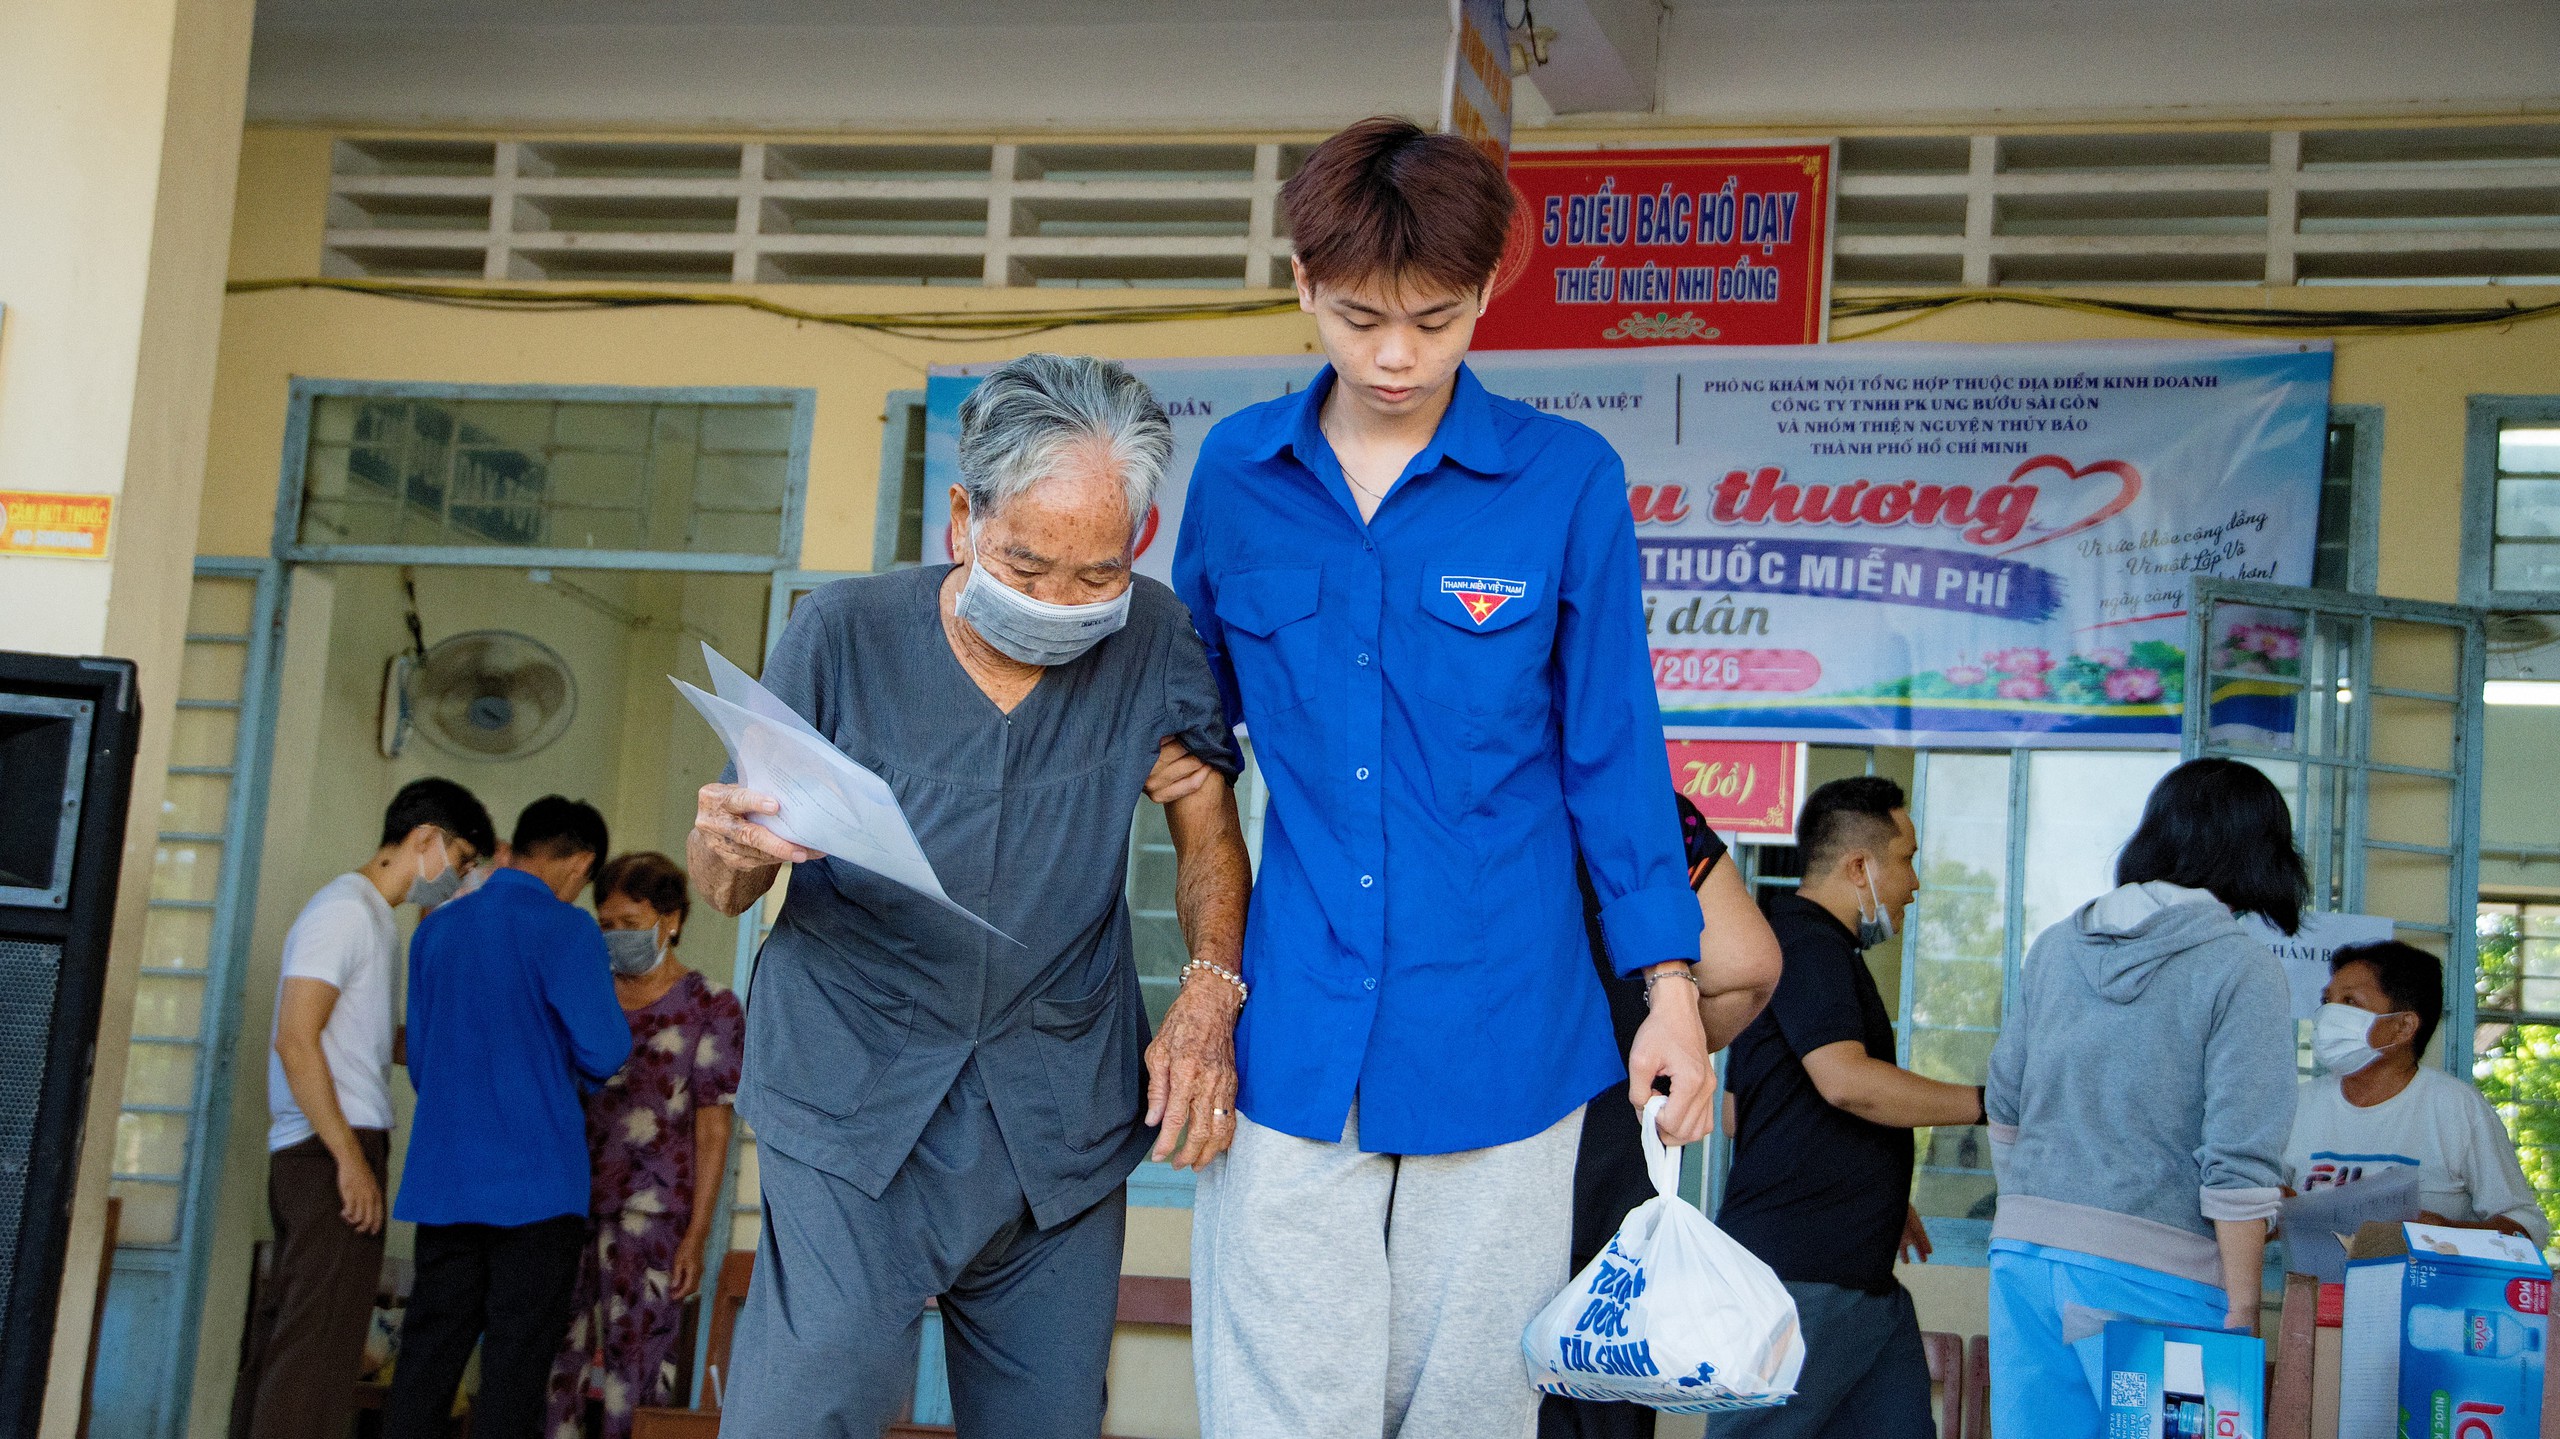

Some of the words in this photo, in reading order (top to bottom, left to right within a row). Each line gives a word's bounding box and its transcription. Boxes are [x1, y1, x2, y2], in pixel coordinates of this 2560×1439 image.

[1543, 196, 1562, 246] 5
[1567, 176, 1631, 245] ĐIỀU
[1635, 183, 1691, 245] BÁC
[1696, 176, 1737, 244] HỒ
[1741, 192, 1798, 254] DẠY
[1553, 257, 1615, 303] THIẾU
[1618, 261, 1670, 303] NIÊN
[1674, 267, 1713, 302] NHI
[1717, 256, 1779, 302] ĐỒNG
[1703, 378, 1764, 393] PHÒNG
[1768, 376, 1819, 392] KHÁM
[1824, 376, 1854, 394] NỘI
[1858, 374, 1907, 391] TỔNG
[1912, 376, 1949, 393] HỢP
[1953, 374, 2014, 393] THUỘC
[2102, 376, 2149, 389] KINH
[2153, 375, 2218, 388] DOANH
[1169, 397, 1212, 415] DÂN
[1596, 391, 1642, 411] VIỆT
[1771, 397, 1820, 412] CÔNG
[1824, 400, 1846, 411] TY
[1849, 400, 1900, 411] TNHH
[1903, 399, 1927, 411] PK
[2026, 395, 2055, 410] SÀI
[2059, 395, 2099, 410] GÒN
[1777, 420, 1799, 433] VÀ
[1804, 417, 1855, 433] NHÓM
[1859, 417, 1914, 435] THIỆN
[1919, 417, 1993, 435] NGUYỆN
[1810, 439, 1872, 454] THÀNH
[1876, 437, 1912, 454] PHỐ
[1916, 437, 1941, 454] HỒ
[1946, 439, 1976, 454] CHÍ
[1981, 441, 2028, 453] MINH
[1713, 467, 2040, 545] thương
[2183, 522, 2224, 546] cộng
[2226, 509, 2268, 532] đồng
[1643, 541, 1785, 585] THUỐC
[1799, 546, 1919, 598] MIỄN
[1934, 562, 2010, 608] PHÍ
[1444, 581, 1468, 589] THANH
[1488, 581, 1503, 594] VIỆT
[1505, 585, 1522, 594] NAM
[1666, 594, 1769, 636] dân
[2270, 942, 2315, 960] HÁM
[2419, 1265, 2428, 1288] CHAI
[2518, 1280, 2533, 1309] MỚI
[2434, 1396, 2446, 1428] NƯỚC
